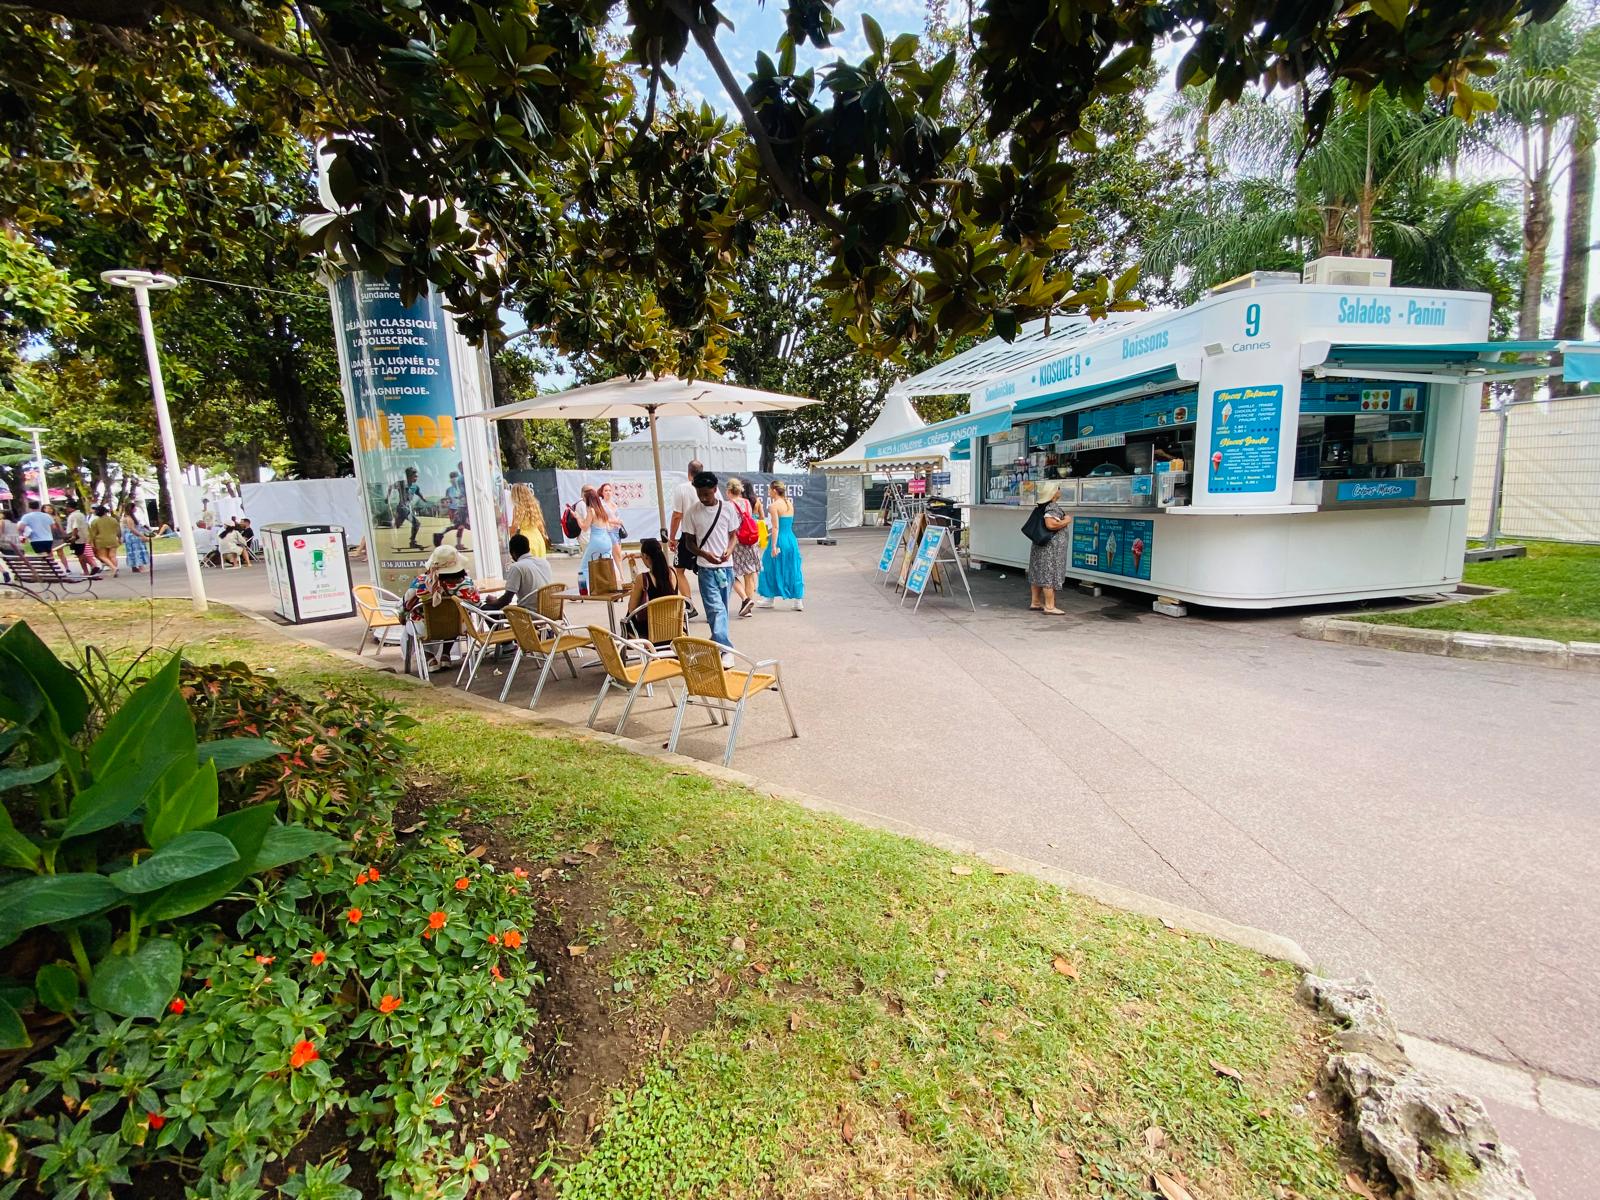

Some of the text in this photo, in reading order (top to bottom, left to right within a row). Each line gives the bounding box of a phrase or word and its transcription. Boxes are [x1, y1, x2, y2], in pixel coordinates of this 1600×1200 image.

[360, 291, 400, 300] sundance
[1338, 297, 1447, 326] Salades Panini
[345, 318, 438, 332] DÉJÀ UN CLASSIQUE
[1245, 303, 1261, 337] 9
[373, 328, 395, 336] FILMS
[396, 328, 413, 336] SUR
[1122, 330, 1169, 360] Boissons
[1232, 340, 1272, 353] Cannes
[374, 358, 386, 366] LA
[388, 355, 425, 366] LIGNÉE
[427, 358, 440, 367] DE
[381, 366, 407, 375] LADY
[1040, 353, 1081, 387] KIOSQUE 9
[928, 432, 950, 445] CRÊPES
[950, 425, 978, 440] MAISON
